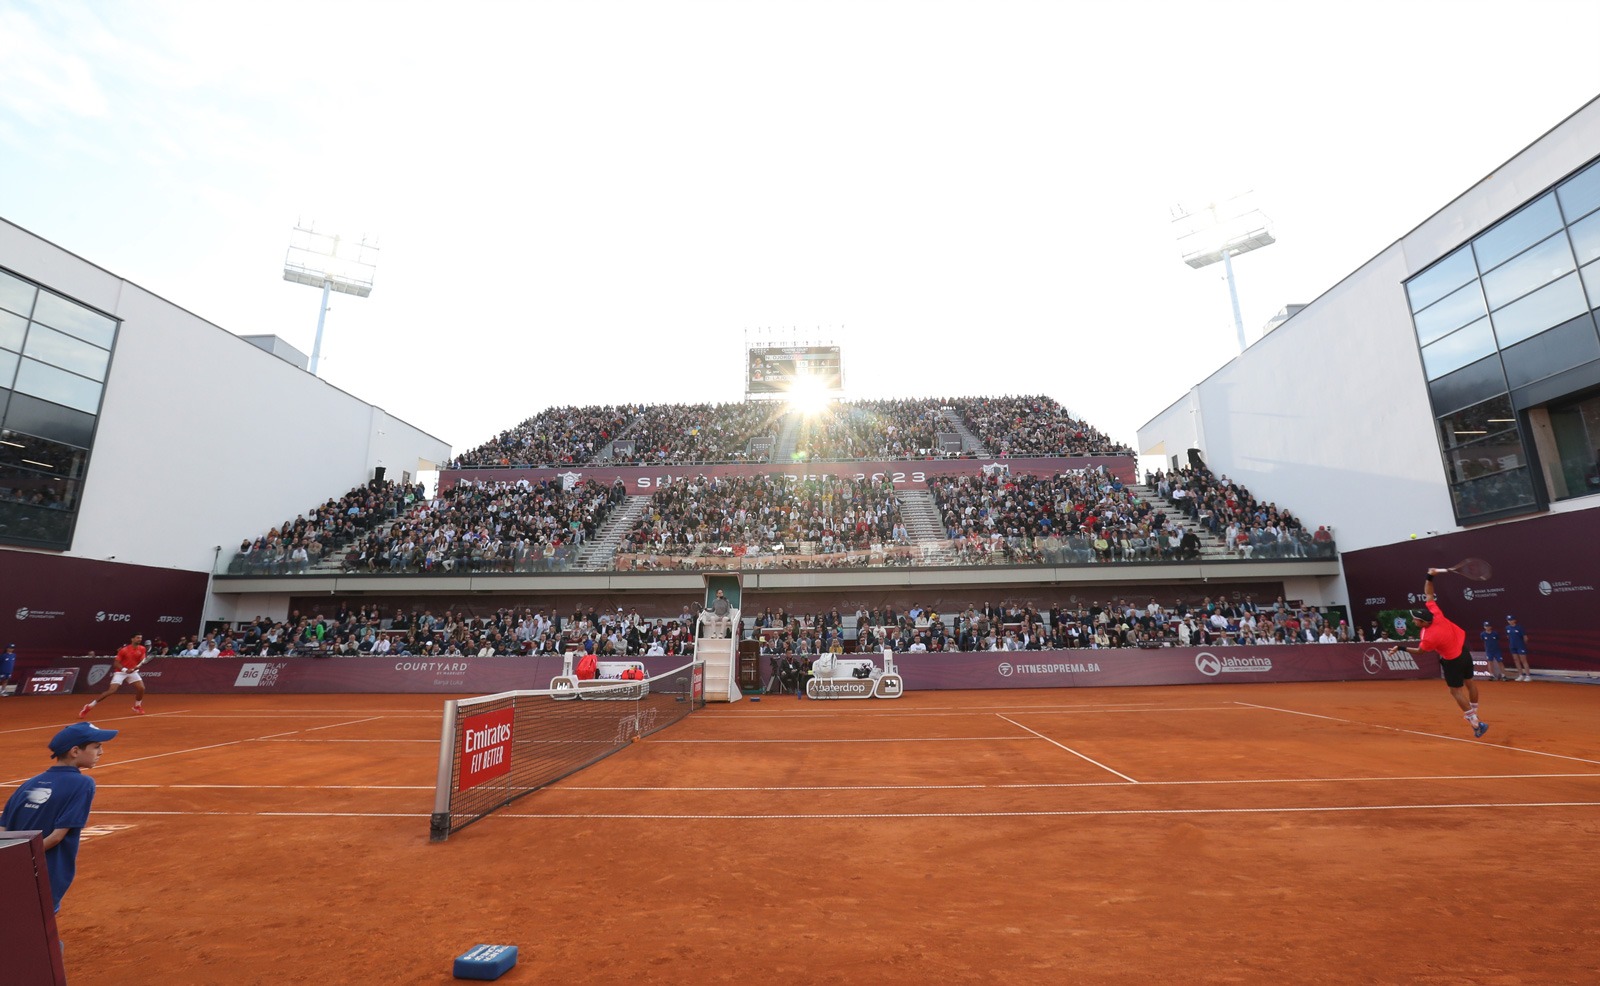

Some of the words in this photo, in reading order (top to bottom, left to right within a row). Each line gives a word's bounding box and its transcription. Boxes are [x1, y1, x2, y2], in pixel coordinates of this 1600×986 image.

[1416, 593, 1437, 602] TCC
[108, 613, 131, 622] TCPC
[395, 662, 468, 671] COURTYARD
[1221, 656, 1272, 667] Jahorina
[1387, 660, 1420, 671] BANKA
[242, 667, 259, 678] BIG
[1016, 663, 1100, 674] FITNESOPREMA.BA
[33, 683, 58, 692] 1:50
[465, 722, 511, 754] Emirates
[470, 752, 483, 775] FLY
[482, 745, 504, 770] BETTER
